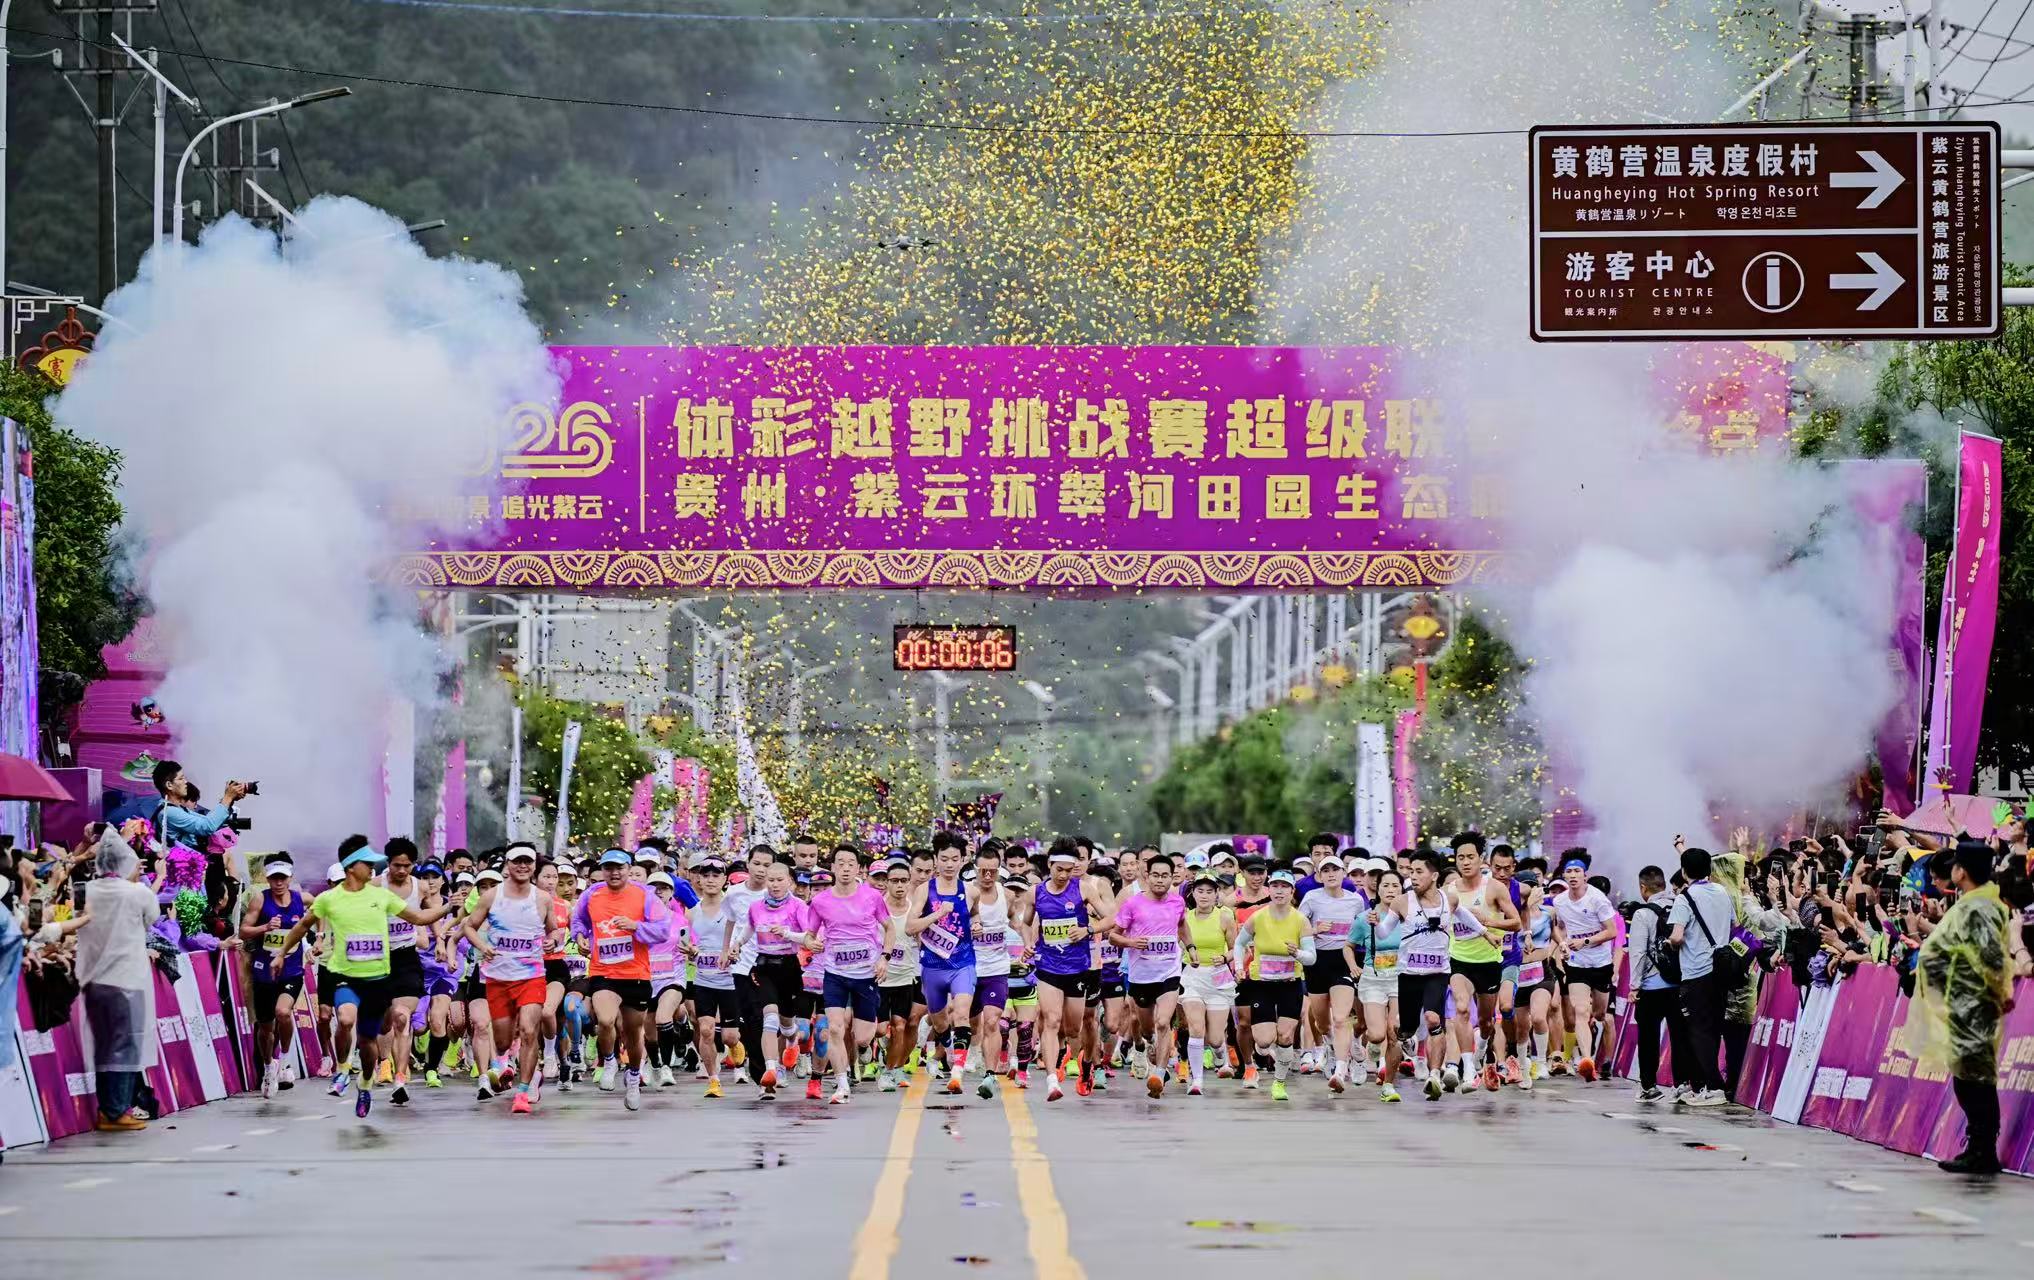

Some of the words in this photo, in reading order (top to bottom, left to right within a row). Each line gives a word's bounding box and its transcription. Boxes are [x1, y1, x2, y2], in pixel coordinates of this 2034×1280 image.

[1551, 143, 1819, 178] 黄鹤营温泉度假村
[1954, 137, 1965, 162] Ziyun
[1552, 186, 1657, 202] Huangheying
[1668, 186, 1695, 198] Hot
[1705, 185, 1757, 201] Spring
[1768, 184, 1819, 198] Resort
[1954, 166, 1966, 228] Huangheying
[1765, 207, 1798, 218] 리조트
[1931, 136, 1950, 323] 紫云黄鹤营旅游景区
[1956, 231, 1966, 263] Tourist
[1565, 250, 1715, 281] 游客中心
[1565, 288, 1635, 298] TOURIST
[1652, 287, 1713, 297] CENTRE
[1956, 267, 1966, 297] Scenic
[1957, 300, 1966, 321] Area
[673, 396, 1500, 460] 体彩越野挑战赛超级联
[501, 495, 604, 521] 追光紫云
[674, 472, 1505, 520] 贵州·紫云环翠河田园生态
[898, 639, 1012, 668] 00:00:06
[346, 940, 384, 952] A1315
[497, 937, 533, 950] A1075
[599, 941, 633, 956] A1076
[835, 948, 870, 962] A1052
[1408, 953, 1443, 966] A1191
